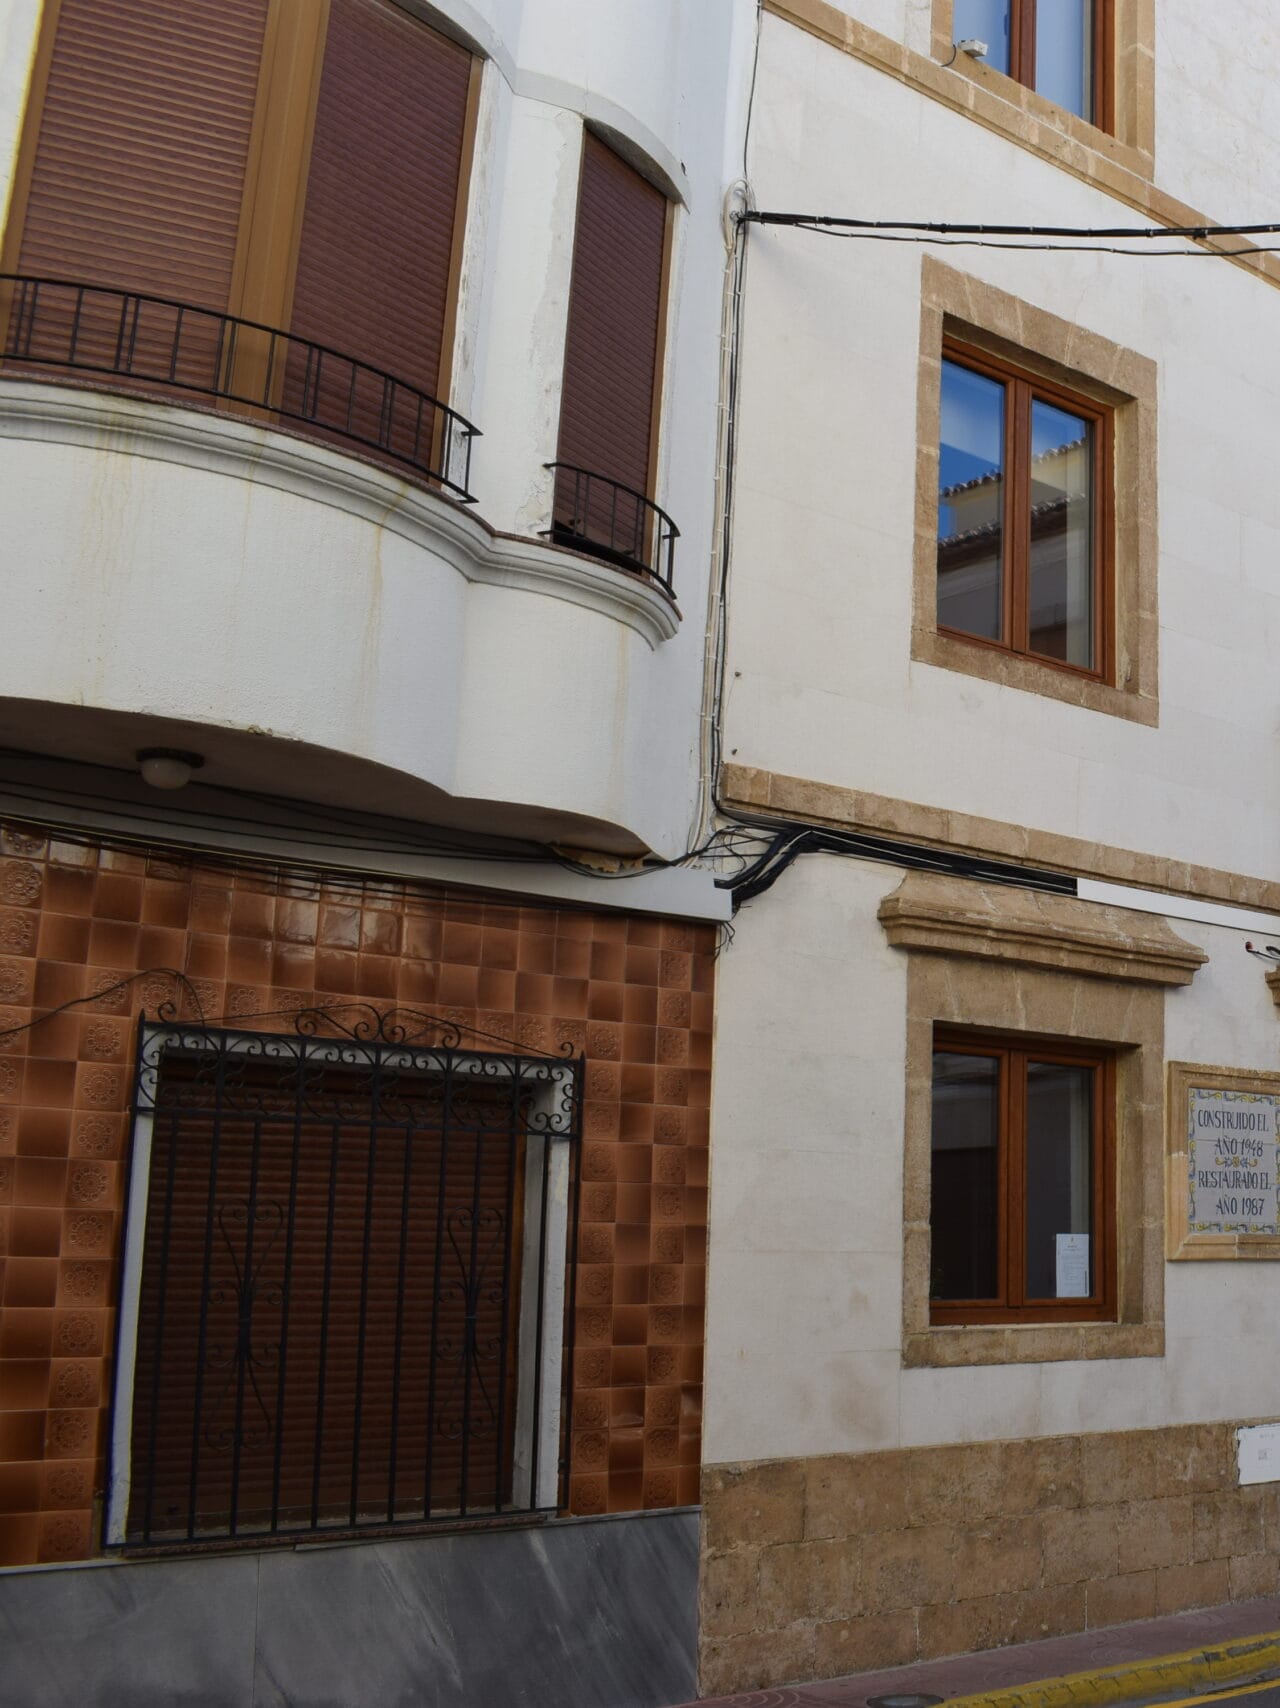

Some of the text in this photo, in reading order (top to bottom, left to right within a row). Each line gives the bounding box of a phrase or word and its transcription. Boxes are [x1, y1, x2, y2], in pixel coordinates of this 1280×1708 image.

[1198, 1109, 1269, 1132] CONSTRUIDO EL
[1215, 1135, 1264, 1157] AÑO 1948
[1198, 1170, 1272, 1190] RESTAURADO EL
[1216, 1194, 1265, 1216] AÑO 1987
